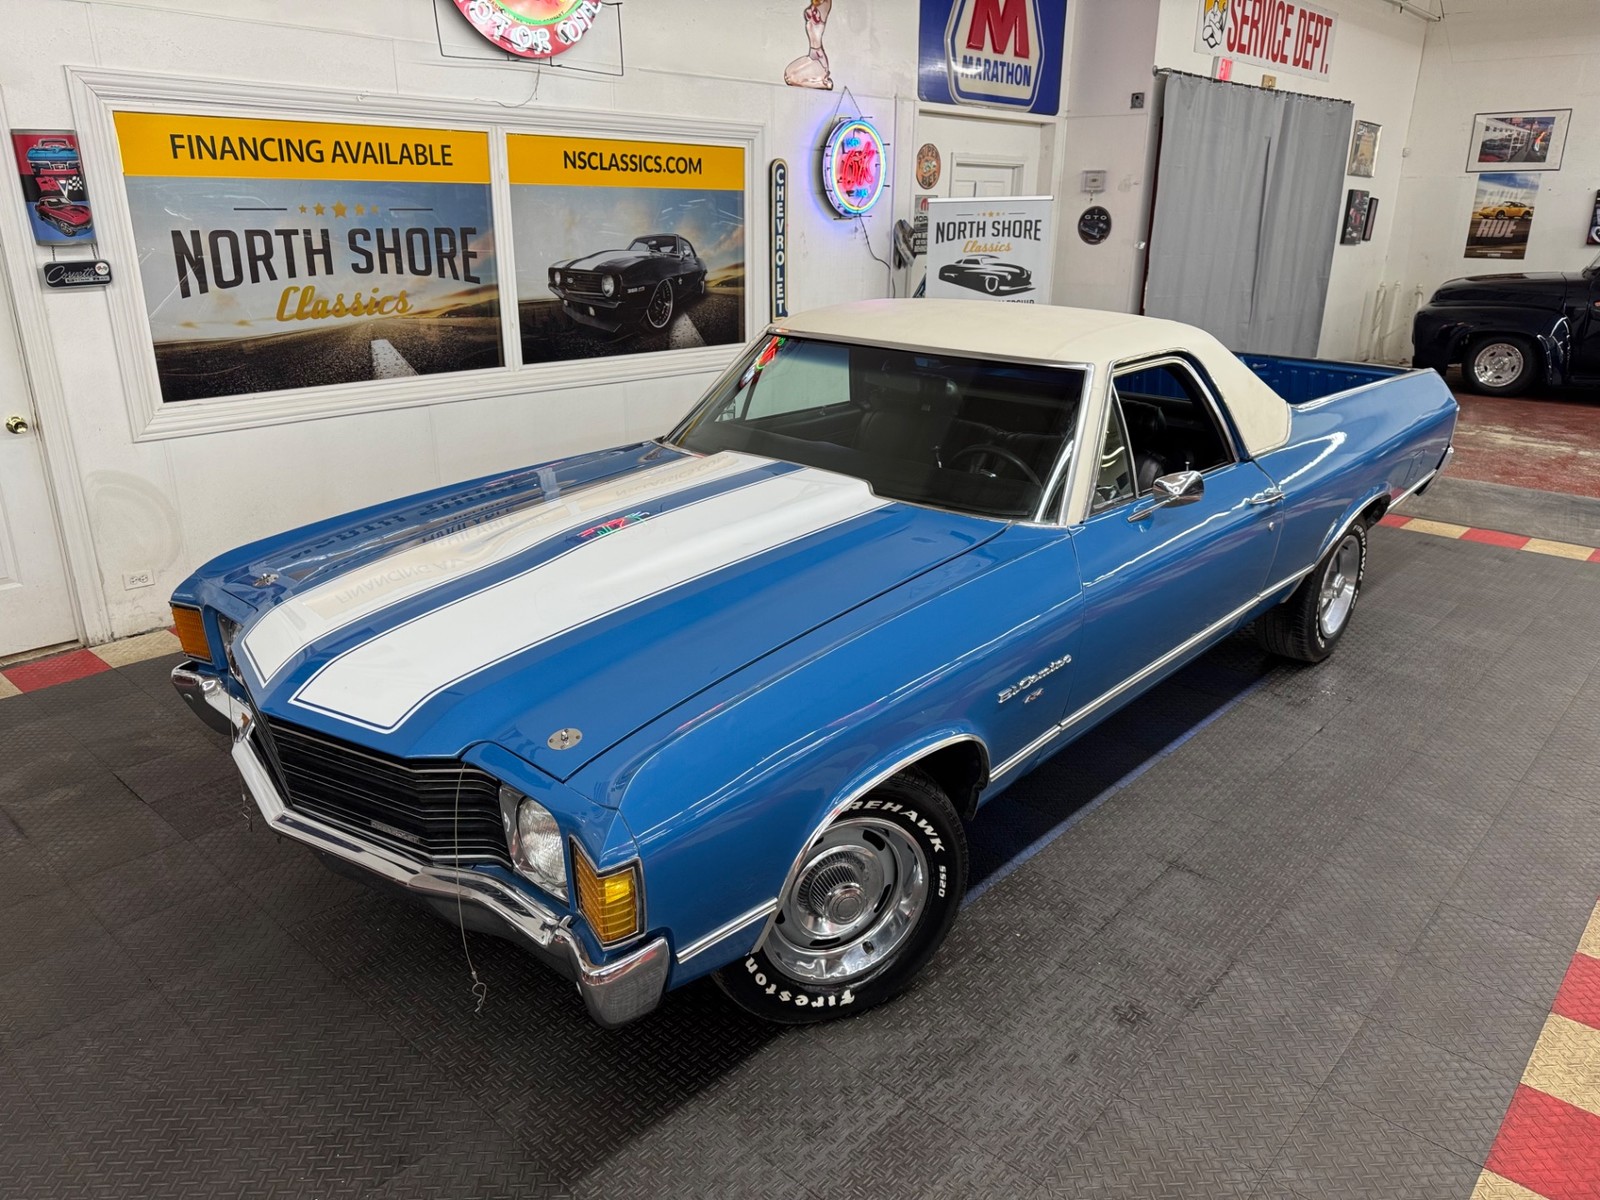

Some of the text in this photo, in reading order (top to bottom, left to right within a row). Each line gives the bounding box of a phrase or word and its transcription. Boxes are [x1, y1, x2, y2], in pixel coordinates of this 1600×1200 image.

[1227, 0, 1333, 74] SERVICE DEPT.
[962, 56, 1031, 88] MARATHON
[170, 133, 453, 167] FINANCING AVAILABLE
[563, 150, 703, 175] NSCLASSICS.COM
[774, 168, 787, 316] CHEVROLET
[935, 220, 987, 244] NORTH
[991, 219, 1042, 241] SHORE
[1475, 219, 1517, 238] RIDE
[170, 225, 481, 298] NORTH SHORE
[962, 239, 1013, 253] Classics
[46, 265, 97, 283] Corvette
[276, 284, 413, 323] Classics
